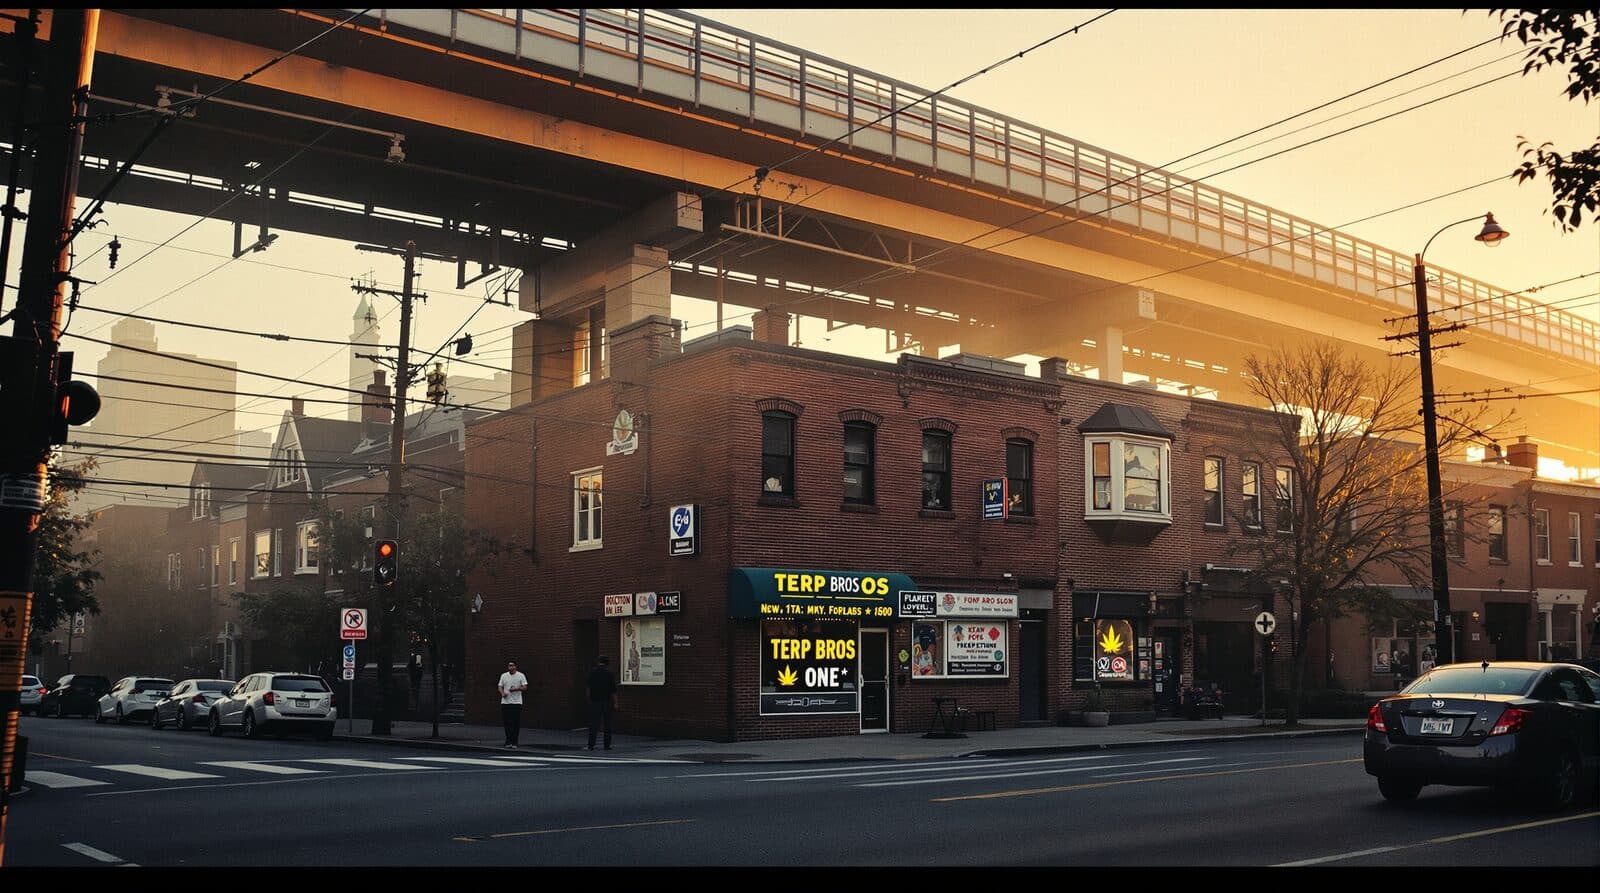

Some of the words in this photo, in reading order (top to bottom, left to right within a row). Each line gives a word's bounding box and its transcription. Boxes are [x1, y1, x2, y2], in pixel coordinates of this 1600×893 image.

[774, 573, 826, 592] TERP
[770, 638, 811, 659] TERP
[815, 639, 856, 660] BROS
